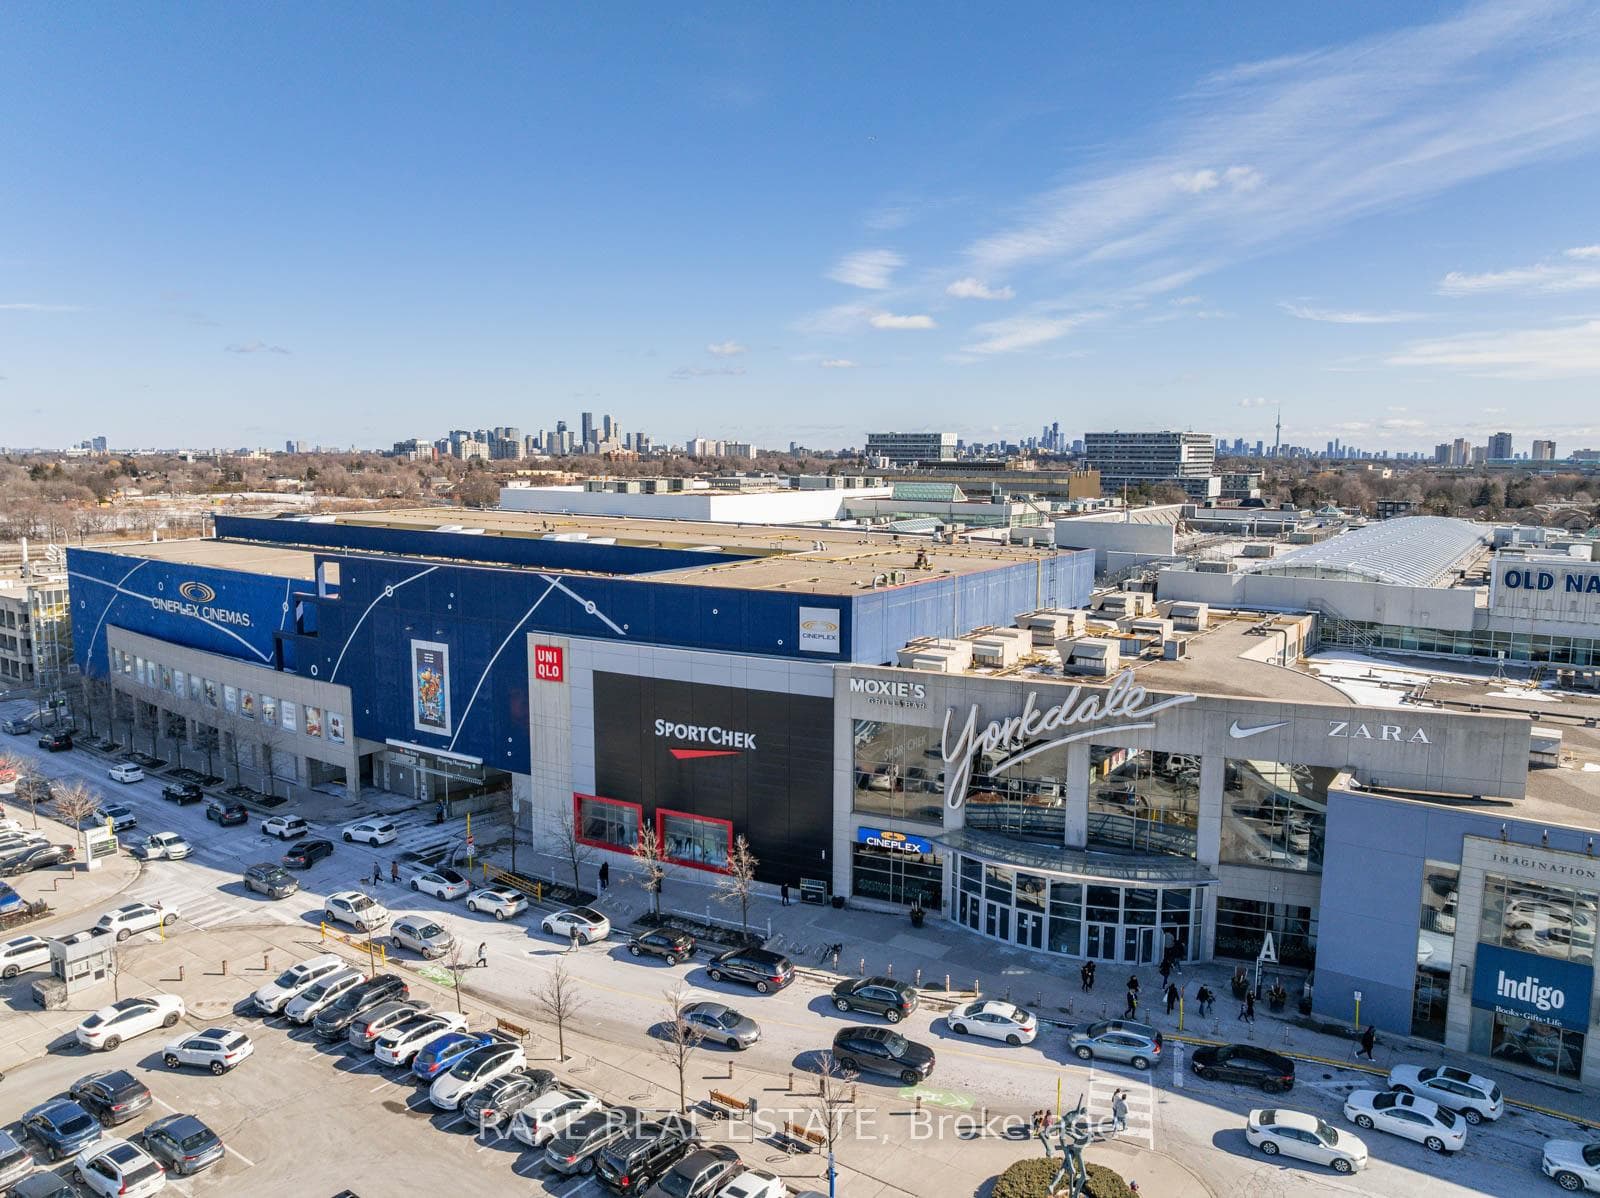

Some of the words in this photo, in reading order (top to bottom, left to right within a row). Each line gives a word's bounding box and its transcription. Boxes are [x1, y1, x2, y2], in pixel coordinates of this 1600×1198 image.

[1504, 570, 1554, 591] OLD
[152, 597, 200, 618] CINEPLEX
[202, 606, 250, 627] CINEMAS
[802, 632, 837, 641] CINEPLEX
[537, 649, 557, 664] UNI
[538, 663, 560, 679] QLO
[849, 678, 926, 699] MOXIE'S
[942, 668, 1197, 810] Yorkdale
[1327, 721, 1433, 744] ZARA
[866, 837, 921, 853] CINEPLEX
[1493, 853, 1596, 878] IMAGINATION
[1260, 932, 1276, 960] A
